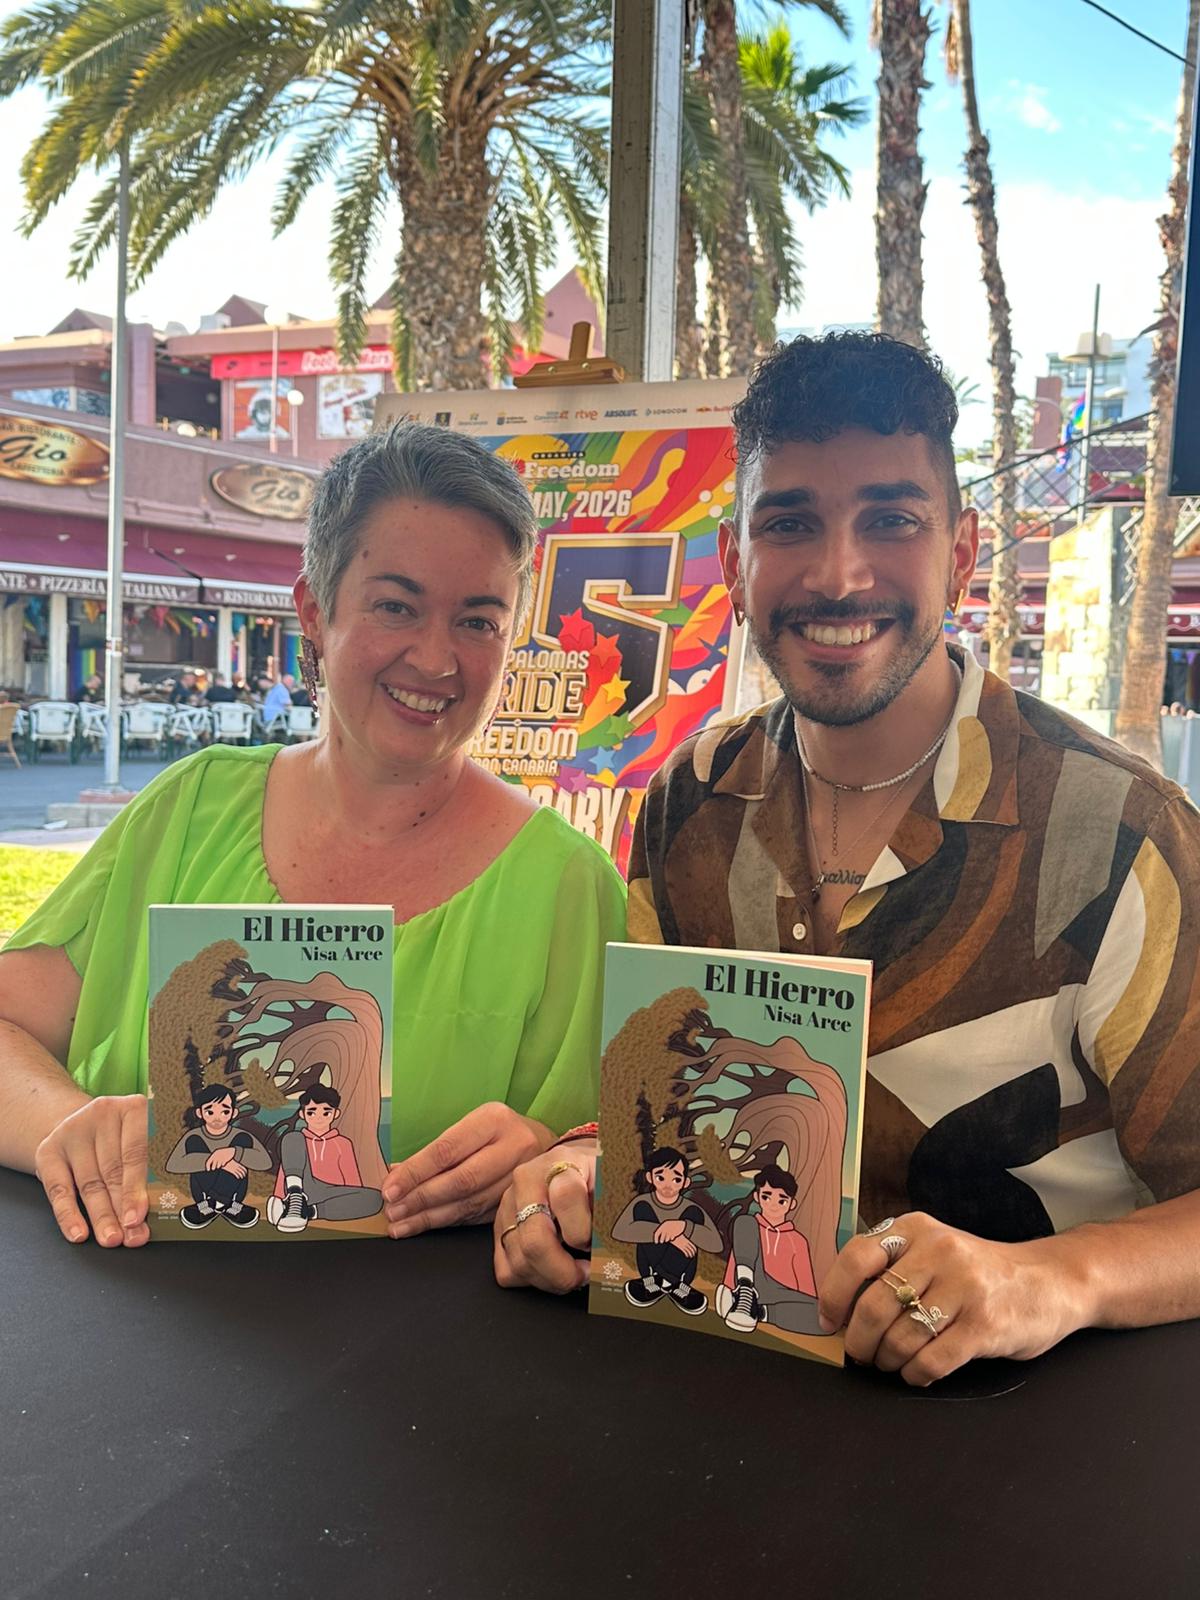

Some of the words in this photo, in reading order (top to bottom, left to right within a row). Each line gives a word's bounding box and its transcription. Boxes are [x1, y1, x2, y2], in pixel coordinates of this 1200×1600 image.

[0, 435, 67, 463] Gio
[524, 460, 620, 479] Freedom
[573, 489, 633, 518] 2026
[465, 726, 579, 758] REEDOM
[502, 758, 558, 775] CANARIA
[243, 916, 273, 942] El
[280, 916, 385, 942] Hierro
[301, 946, 337, 961] Nisa
[342, 947, 383, 961] Arce
[704, 963, 736, 994] El
[744, 968, 855, 1010] Hierro
[764, 1004, 802, 1026] Nisa
[806, 1011, 852, 1033] Arce
